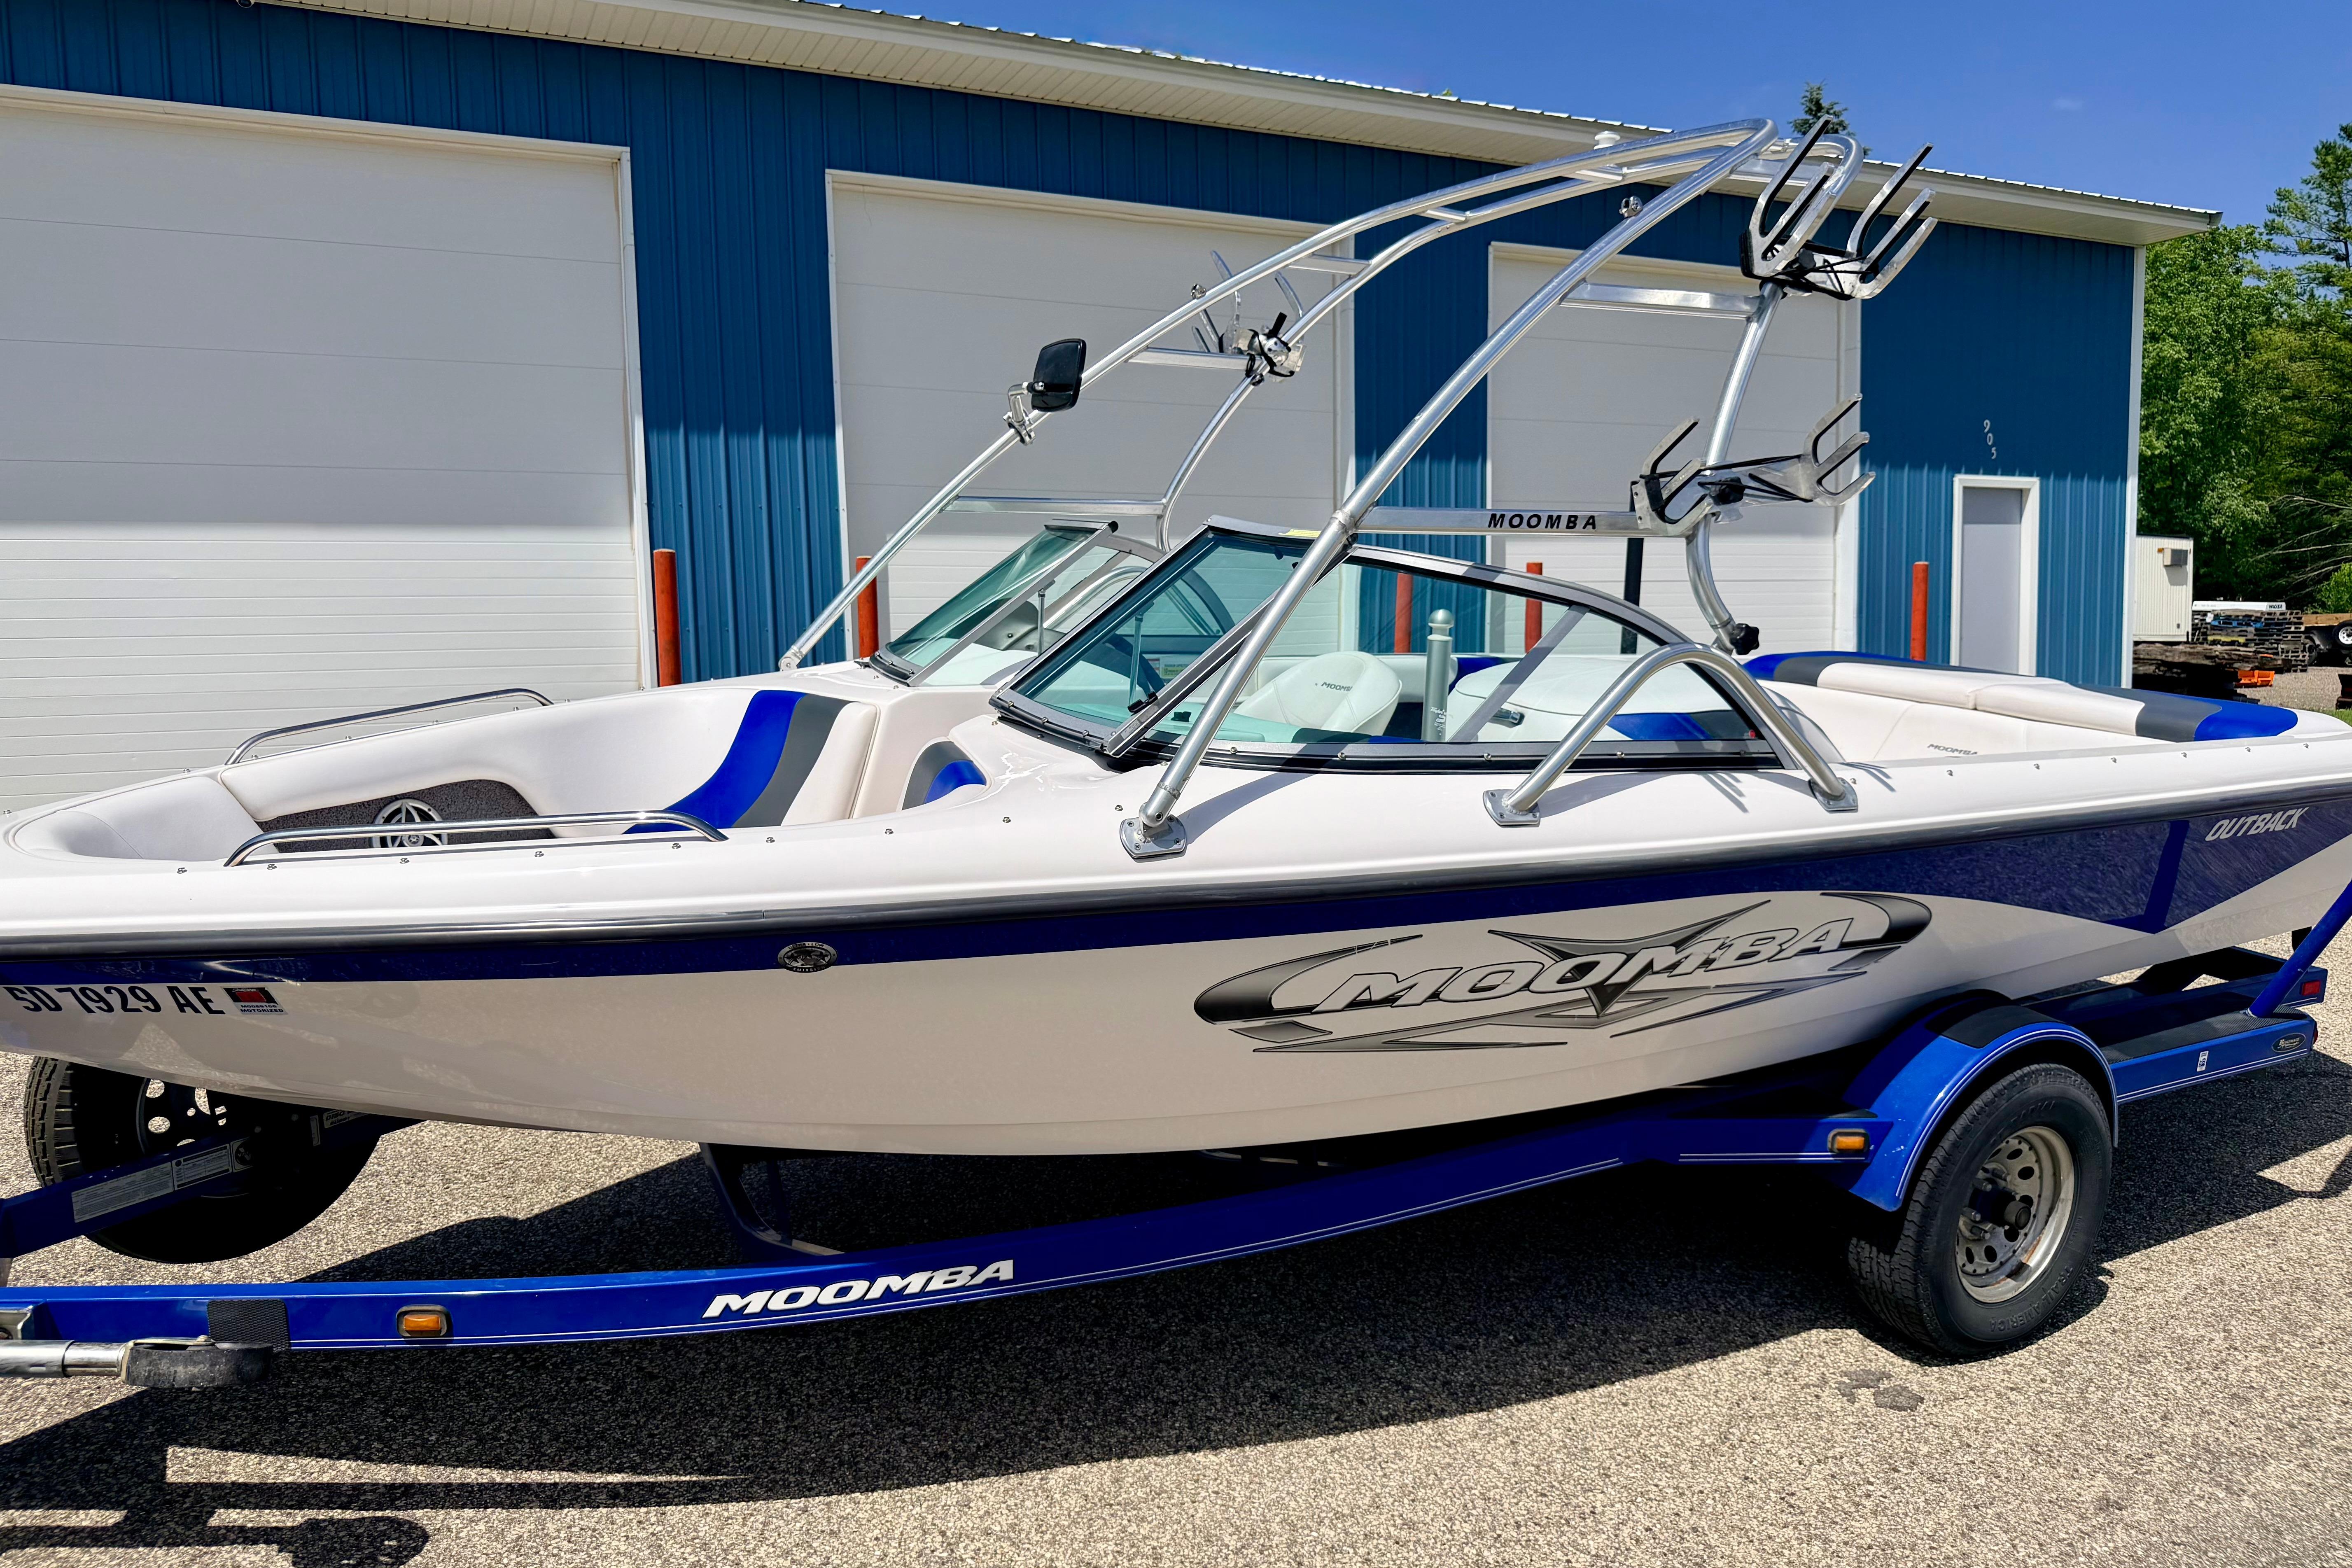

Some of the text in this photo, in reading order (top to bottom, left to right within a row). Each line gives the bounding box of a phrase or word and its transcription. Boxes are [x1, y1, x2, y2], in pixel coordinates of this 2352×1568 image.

[1983, 419, 1997, 459] 905
[1488, 513, 1597, 530] MOOMBA
[1927, 743, 1978, 755] MOOMBA
[2205, 807, 2309, 841] OUTBACK
[1312, 917, 1854, 1012] MOOMBA
[2, 986, 226, 1015] SD 7929 AE
[701, 1260, 1014, 1319] MOOMBA
